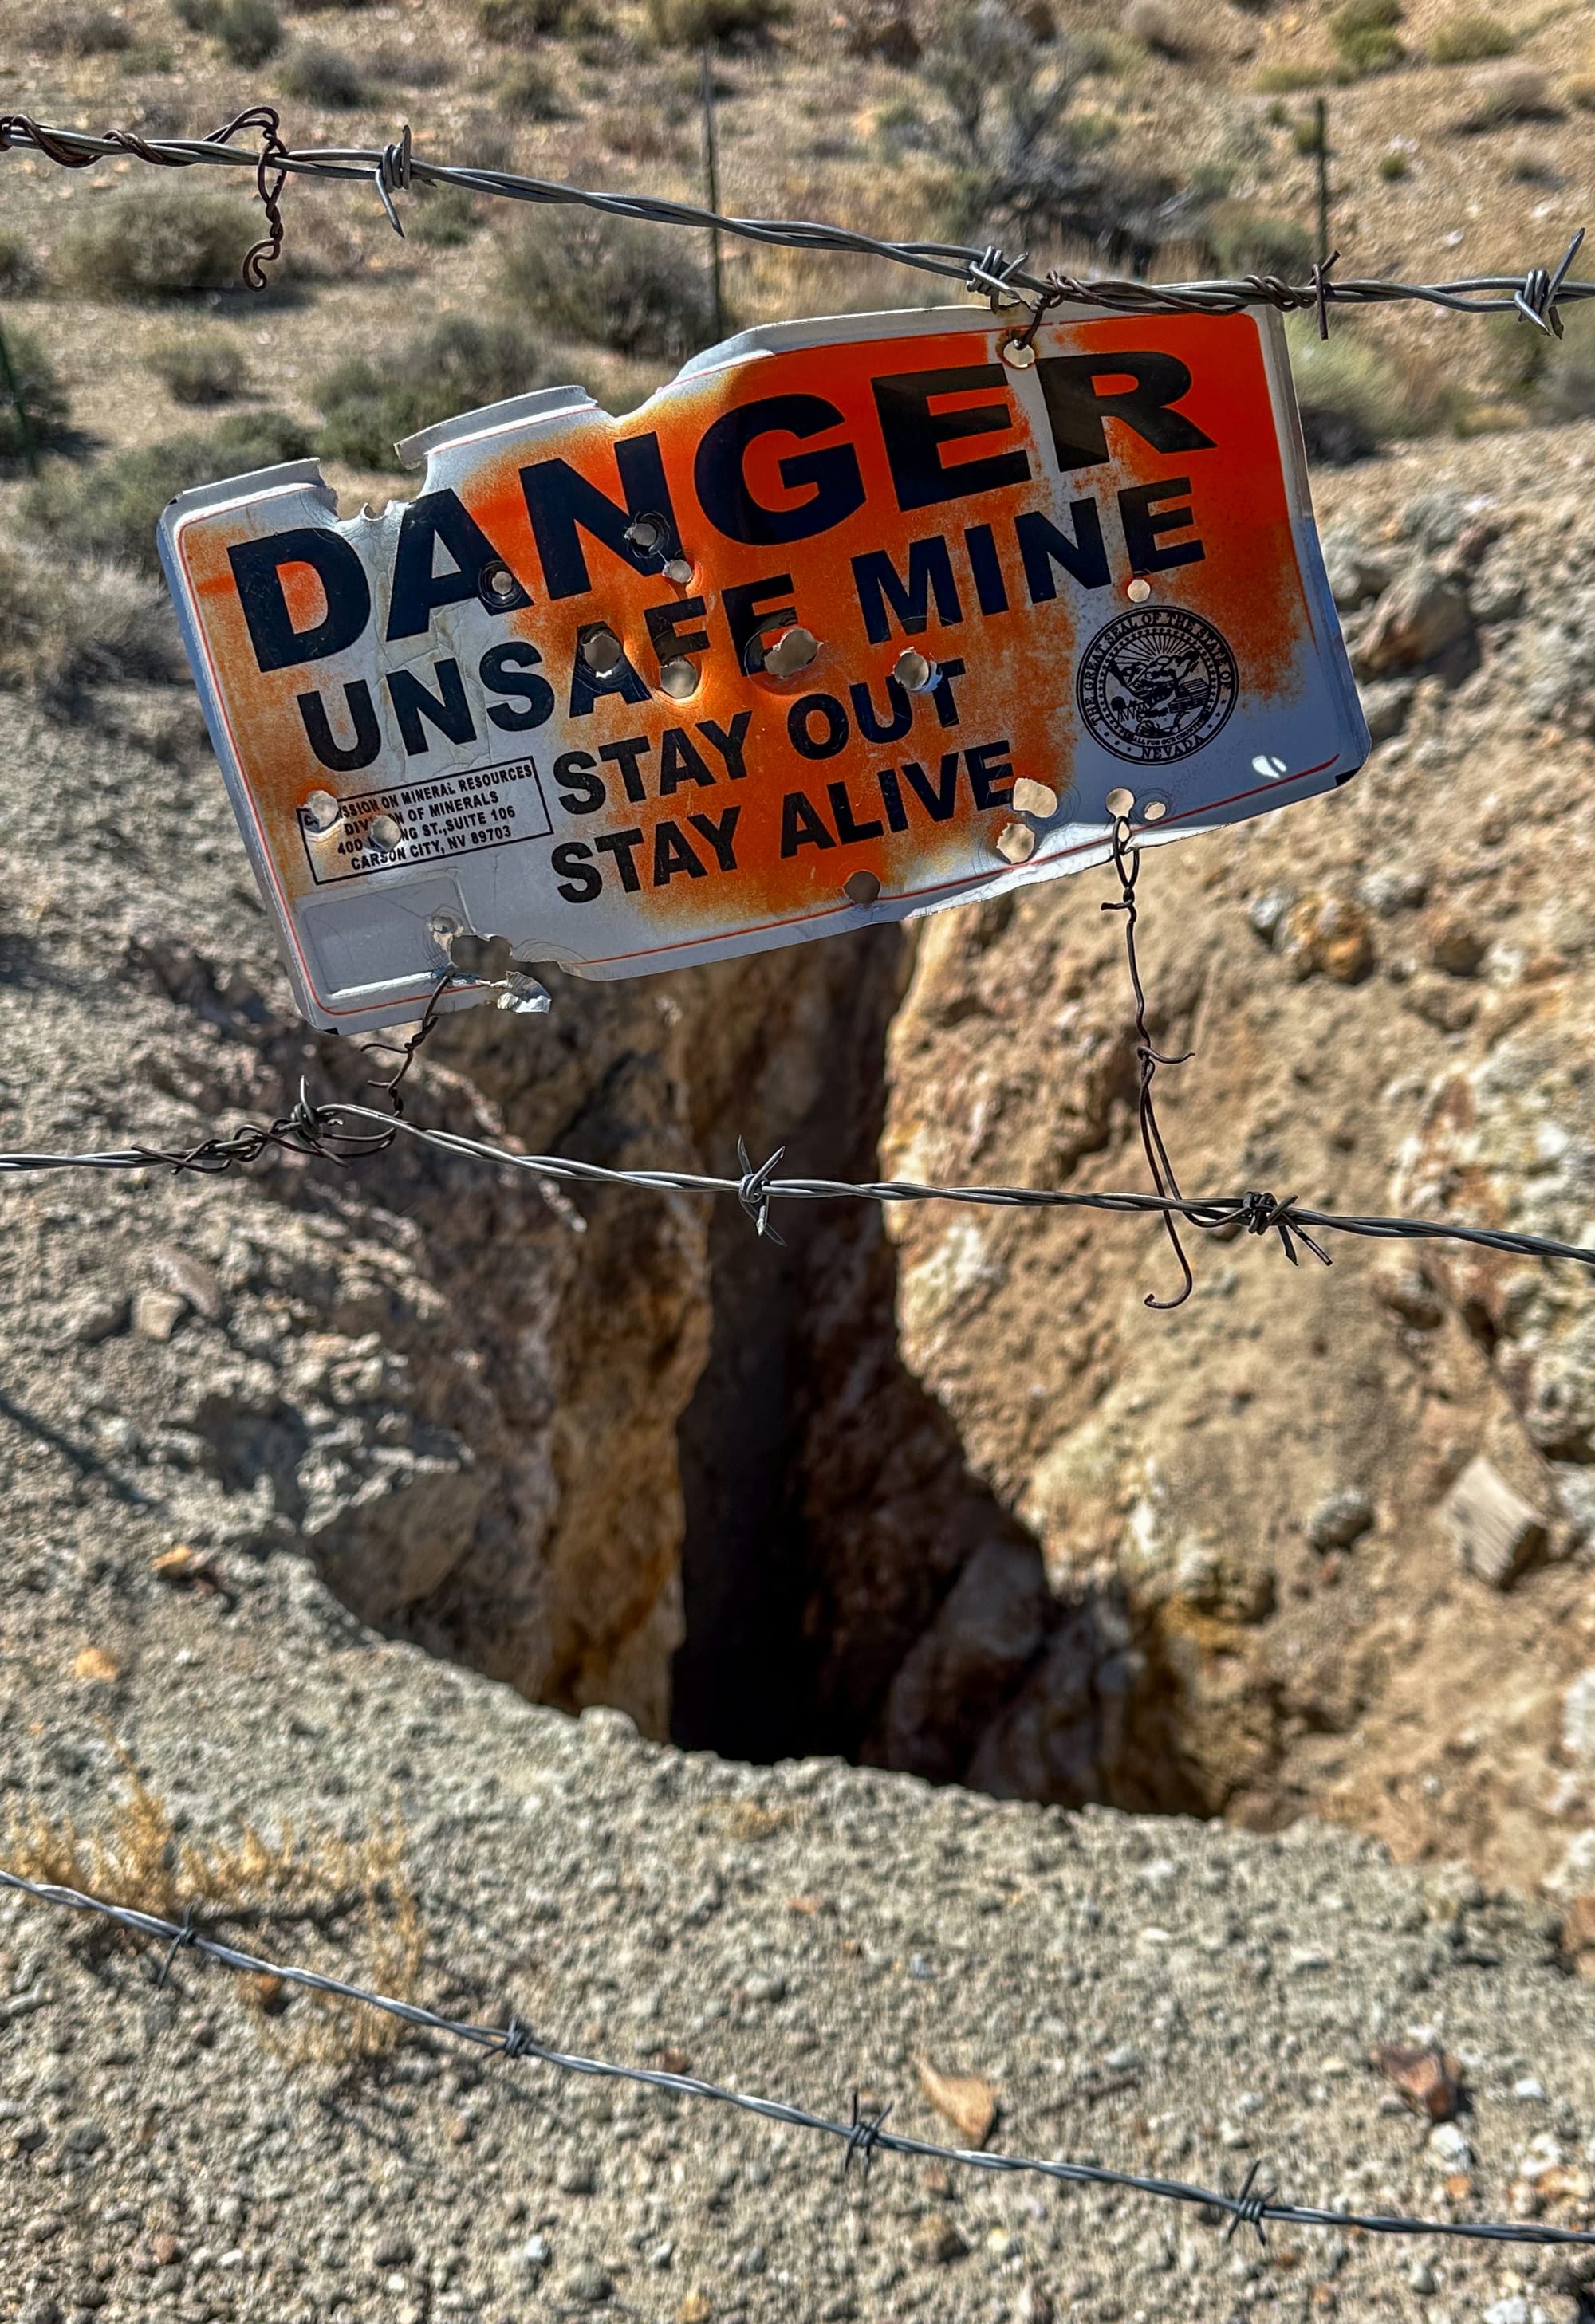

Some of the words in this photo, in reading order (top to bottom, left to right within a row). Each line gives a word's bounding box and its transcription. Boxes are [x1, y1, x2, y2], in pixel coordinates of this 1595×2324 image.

[227, 352, 1218, 673] DANGER
[296, 573, 799, 772] UNSAFE
[851, 477, 1205, 644] MINE
[1105, 619, 1139, 645] SEAL
[1141, 612, 1162, 626] OF
[1168, 613, 1196, 631] THE
[1085, 644, 1107, 691] GREAT
[1219, 670, 1233, 690] OF
[1085, 697, 1101, 726] THE
[553, 711, 752, 815] STAY
[788, 659, 967, 760] OUT
[1141, 734, 1206, 759] NEVADA
[381, 794, 399, 808] ON
[401, 782, 456, 805] MINERAL
[458, 764, 533, 792] RESOURCES
[408, 807, 425, 820] OF
[429, 791, 499, 818] MINERALS
[337, 838, 363, 855] 400
[491, 805, 516, 821] 106
[551, 807, 742, 903] STAY
[780, 740, 1015, 859] ALIVE
[351, 847, 407, 871] CARSON
[410, 840, 446, 858] CITY,
[447, 834, 467, 851] NV
[471, 825, 511, 845] 89703
